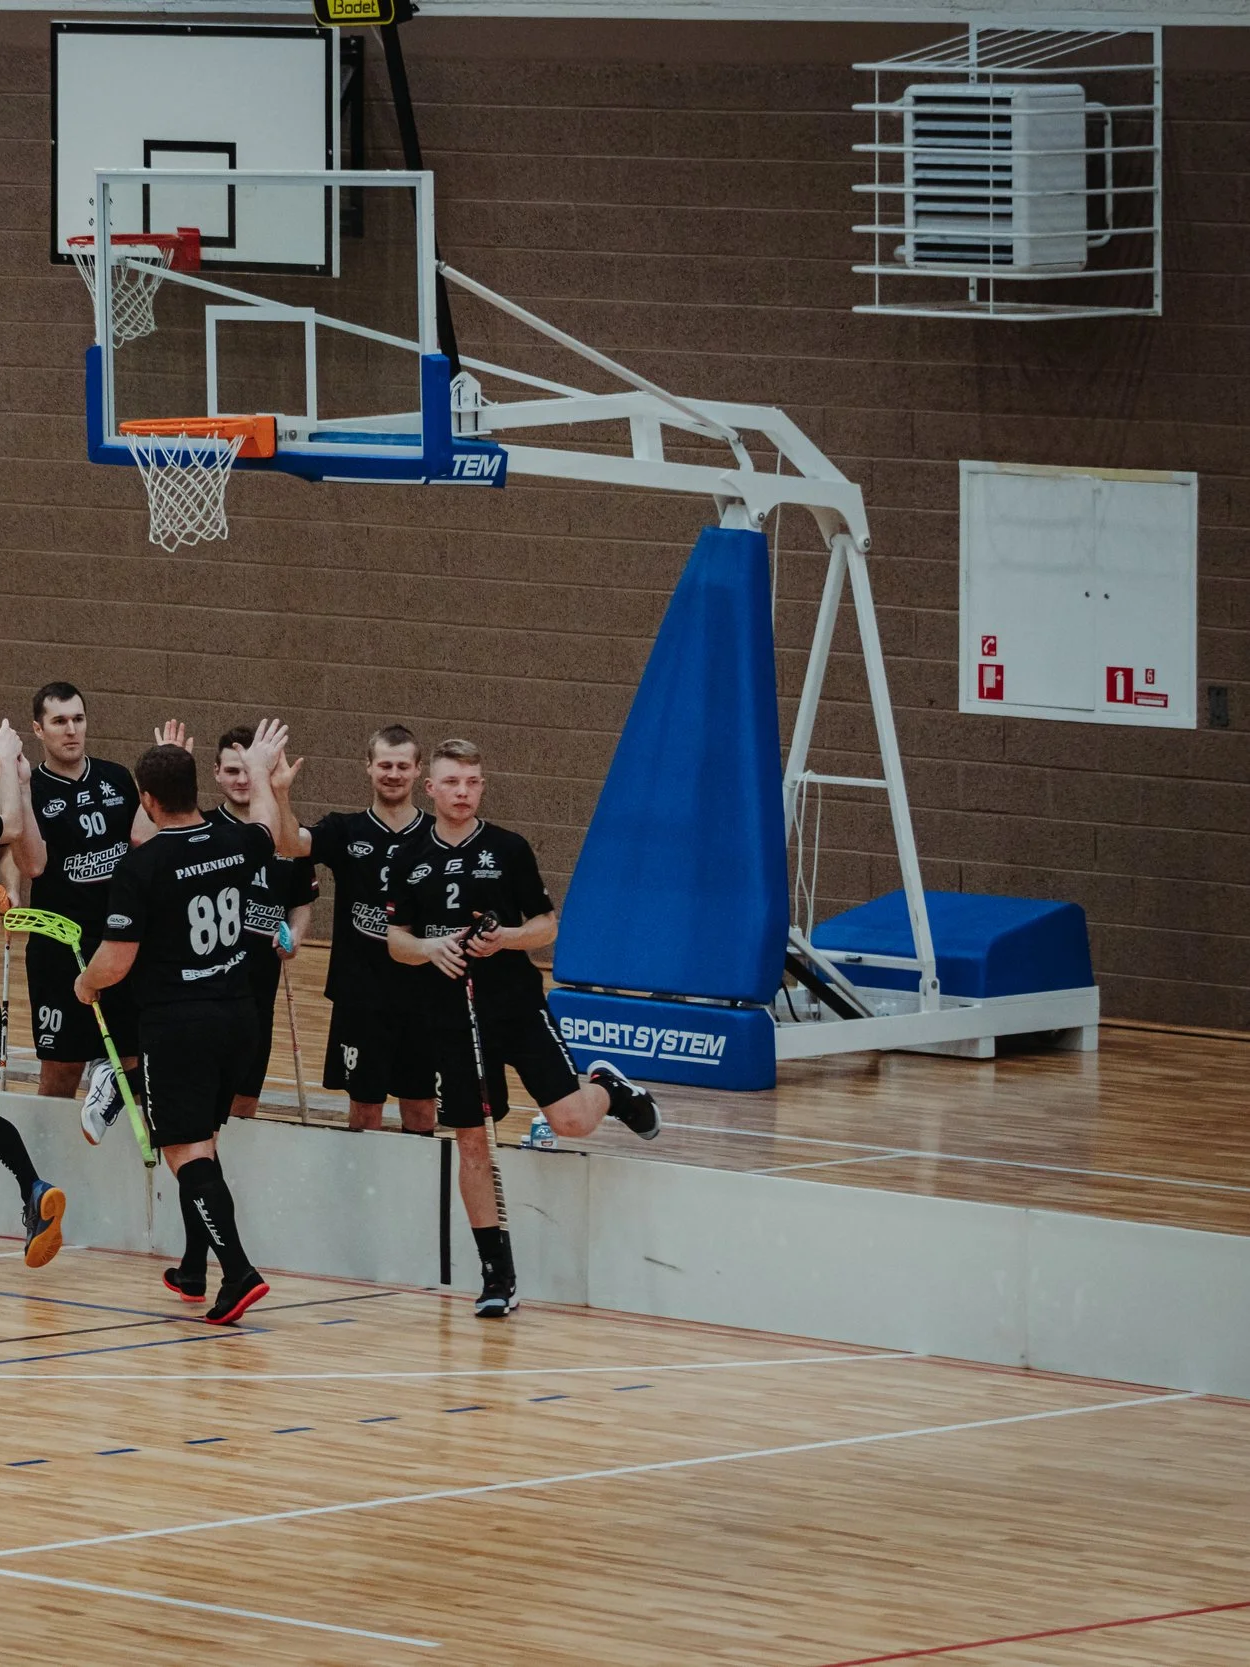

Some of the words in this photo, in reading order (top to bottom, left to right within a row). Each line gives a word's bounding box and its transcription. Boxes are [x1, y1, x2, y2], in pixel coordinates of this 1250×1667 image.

[332, 0, 376, 15] Bodet
[451, 454, 503, 477] TEM
[1146, 670, 1153, 683] 6
[79, 812, 107, 838] 90
[352, 843, 372, 856] KSC
[446, 882, 460, 910] 2
[188, 887, 242, 955] 88
[39, 1006, 62, 1032] 90
